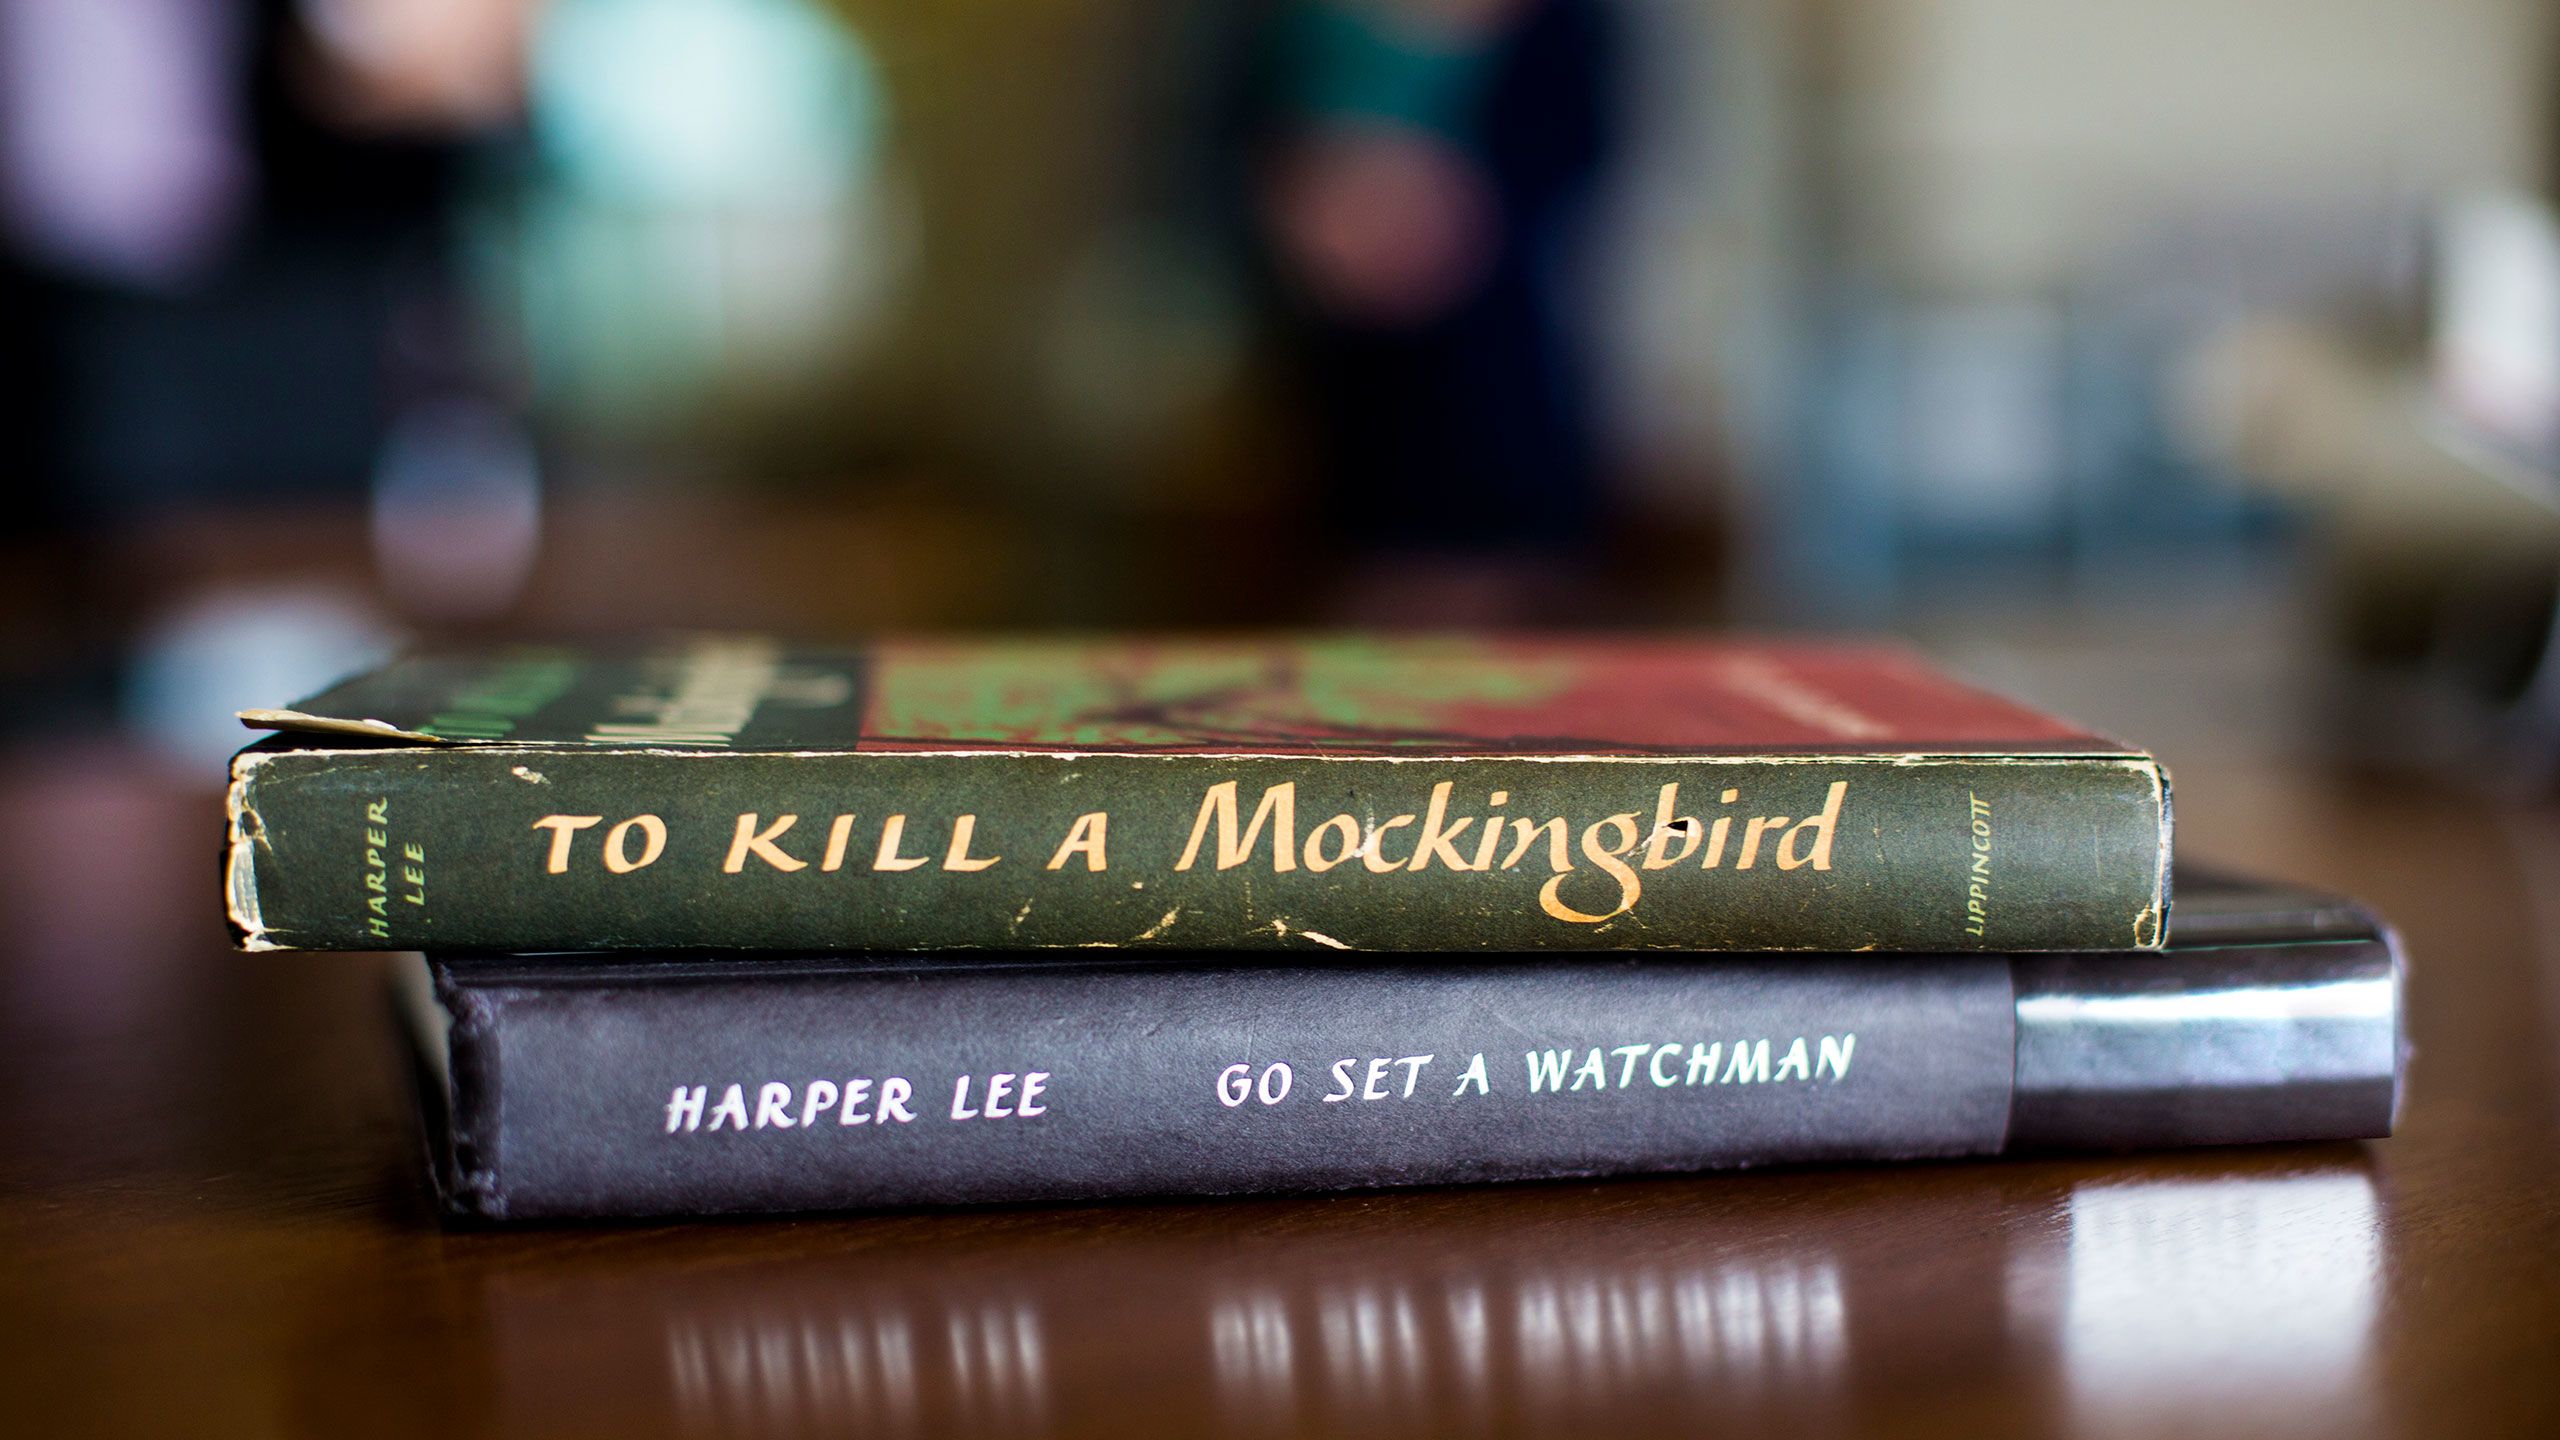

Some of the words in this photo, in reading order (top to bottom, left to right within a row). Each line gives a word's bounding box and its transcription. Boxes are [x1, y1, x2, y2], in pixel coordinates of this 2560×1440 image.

[365, 797, 389, 938] HARPER
[404, 841, 425, 906] LEE
[532, 813, 668, 874] TO
[723, 812, 1001, 873] KILL
[1046, 811, 1107, 872] A
[1174, 780, 1848, 923] Mockingbird
[1965, 790, 1992, 937] LIPPINCOTT
[664, 1076, 917, 1134] HARPER
[949, 1071, 1051, 1121] LEE
[1216, 1061, 1293, 1107] GO
[1322, 1054, 1434, 1102] SET
[1452, 1052, 1490, 1096] A
[1525, 1032, 1857, 1093] WATCHMAN
